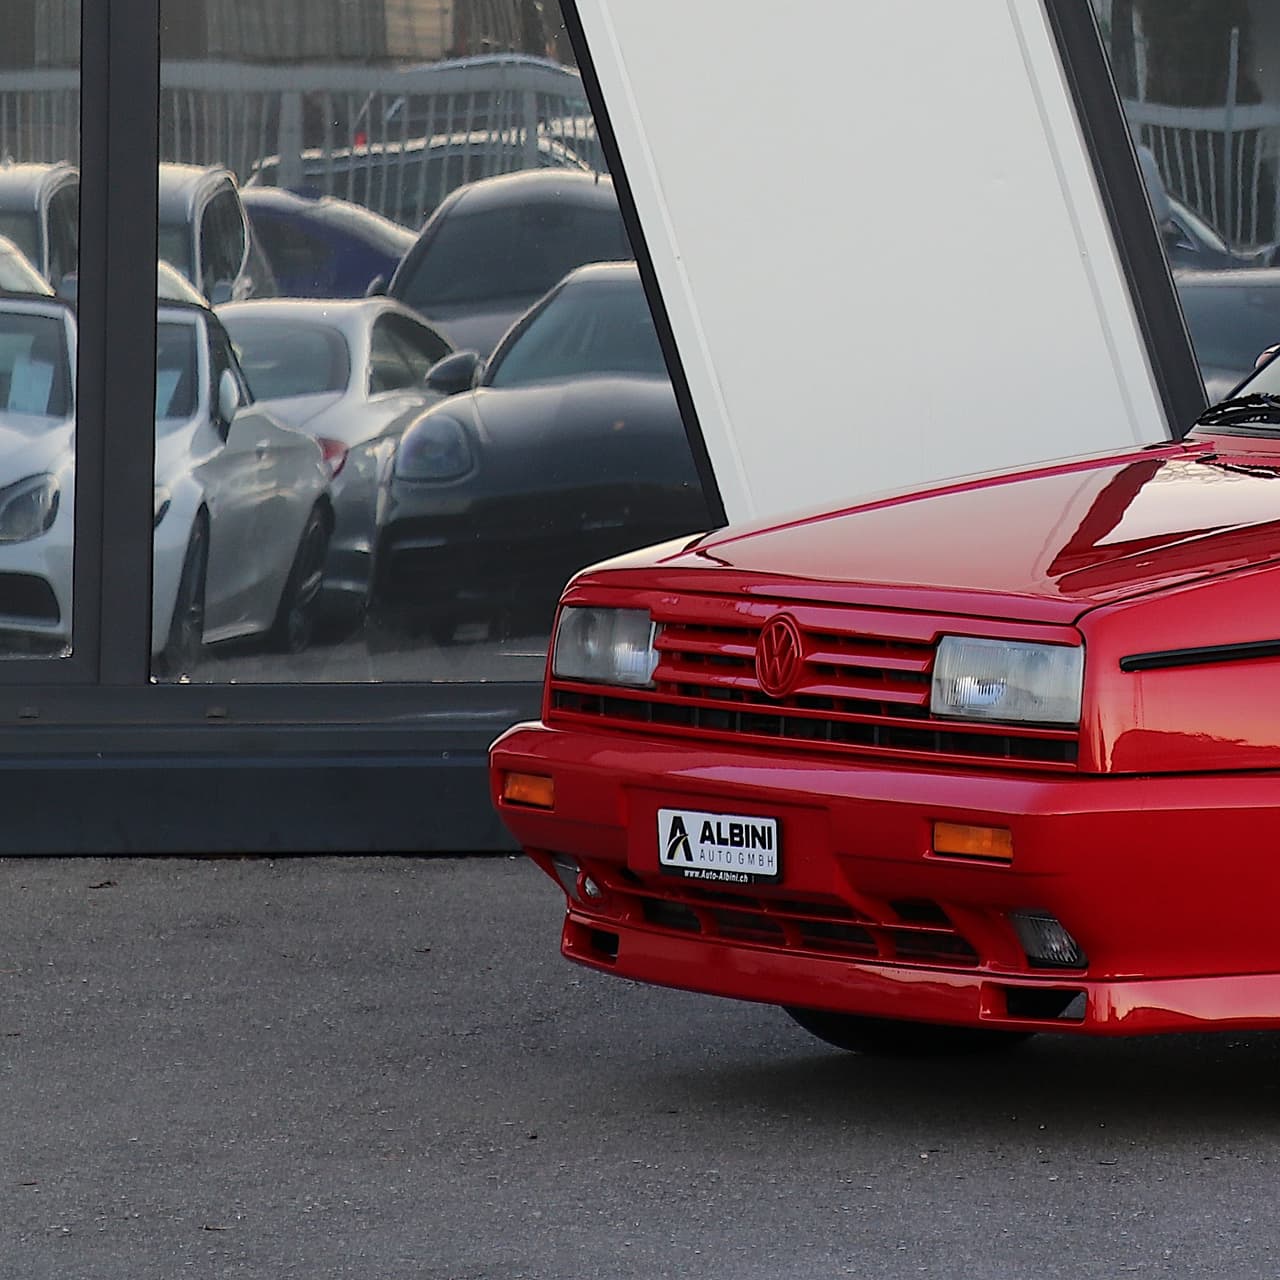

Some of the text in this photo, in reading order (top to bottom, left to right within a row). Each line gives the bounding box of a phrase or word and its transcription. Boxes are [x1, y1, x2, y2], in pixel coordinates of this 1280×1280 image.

[699, 820, 773, 851] ALBINI
[700, 849, 774, 868] AUTO GMBH
